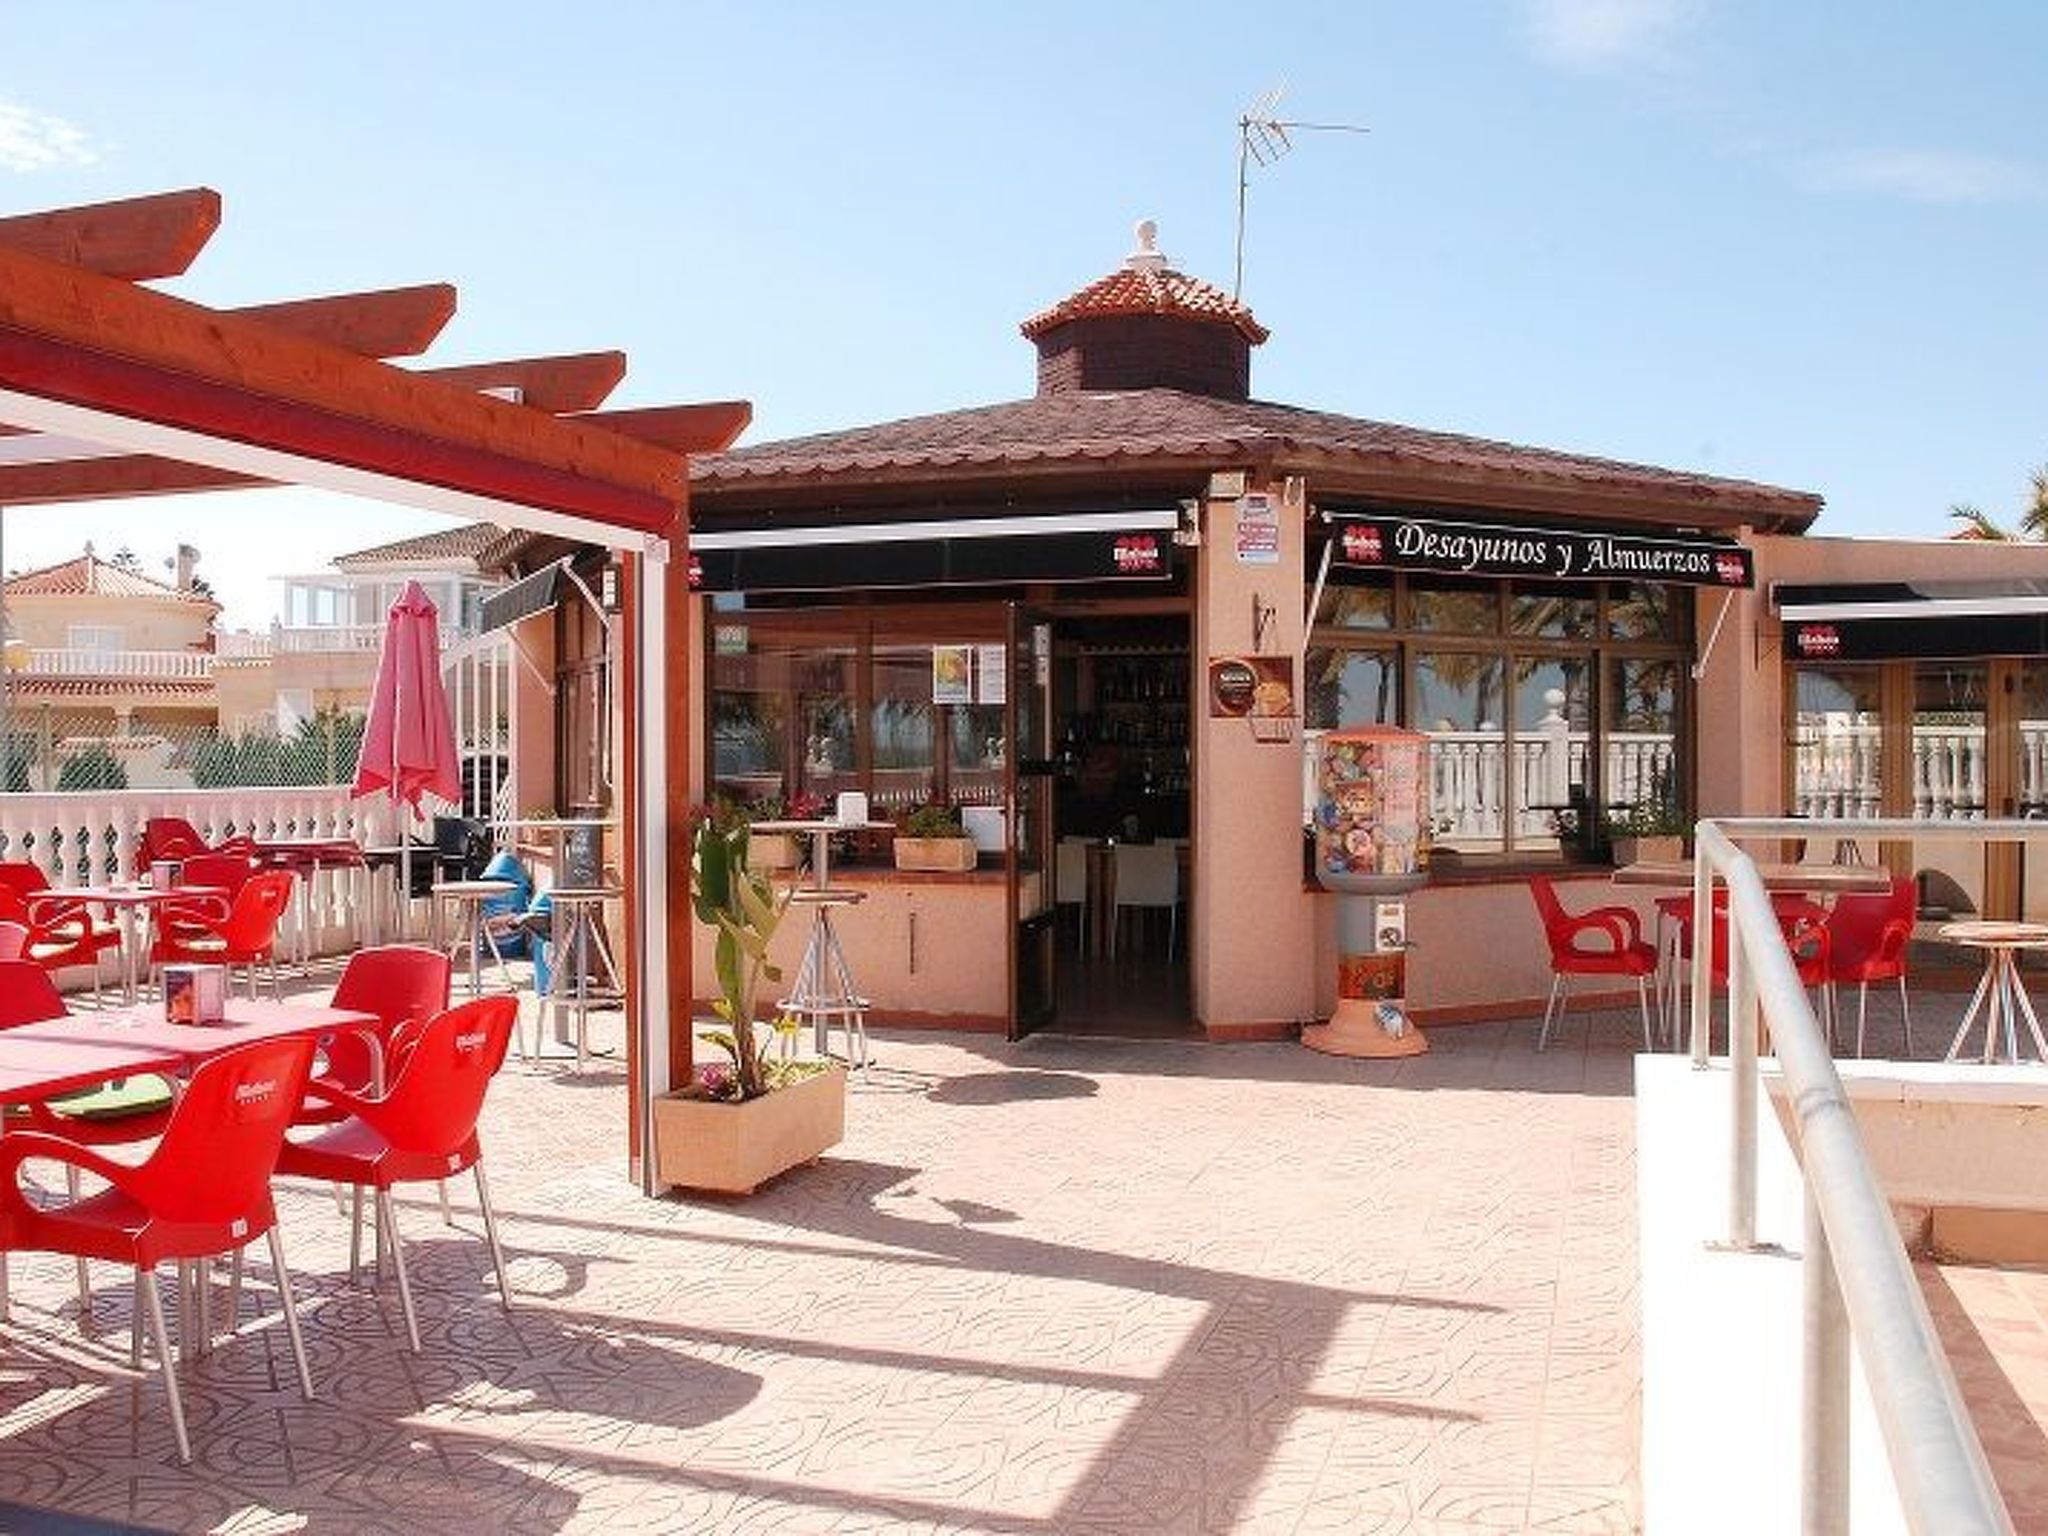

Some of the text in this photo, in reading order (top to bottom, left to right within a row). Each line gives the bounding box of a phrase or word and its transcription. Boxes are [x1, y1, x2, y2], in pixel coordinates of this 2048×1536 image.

[1395, 524, 1711, 576] Desayunos y Almuerzos
